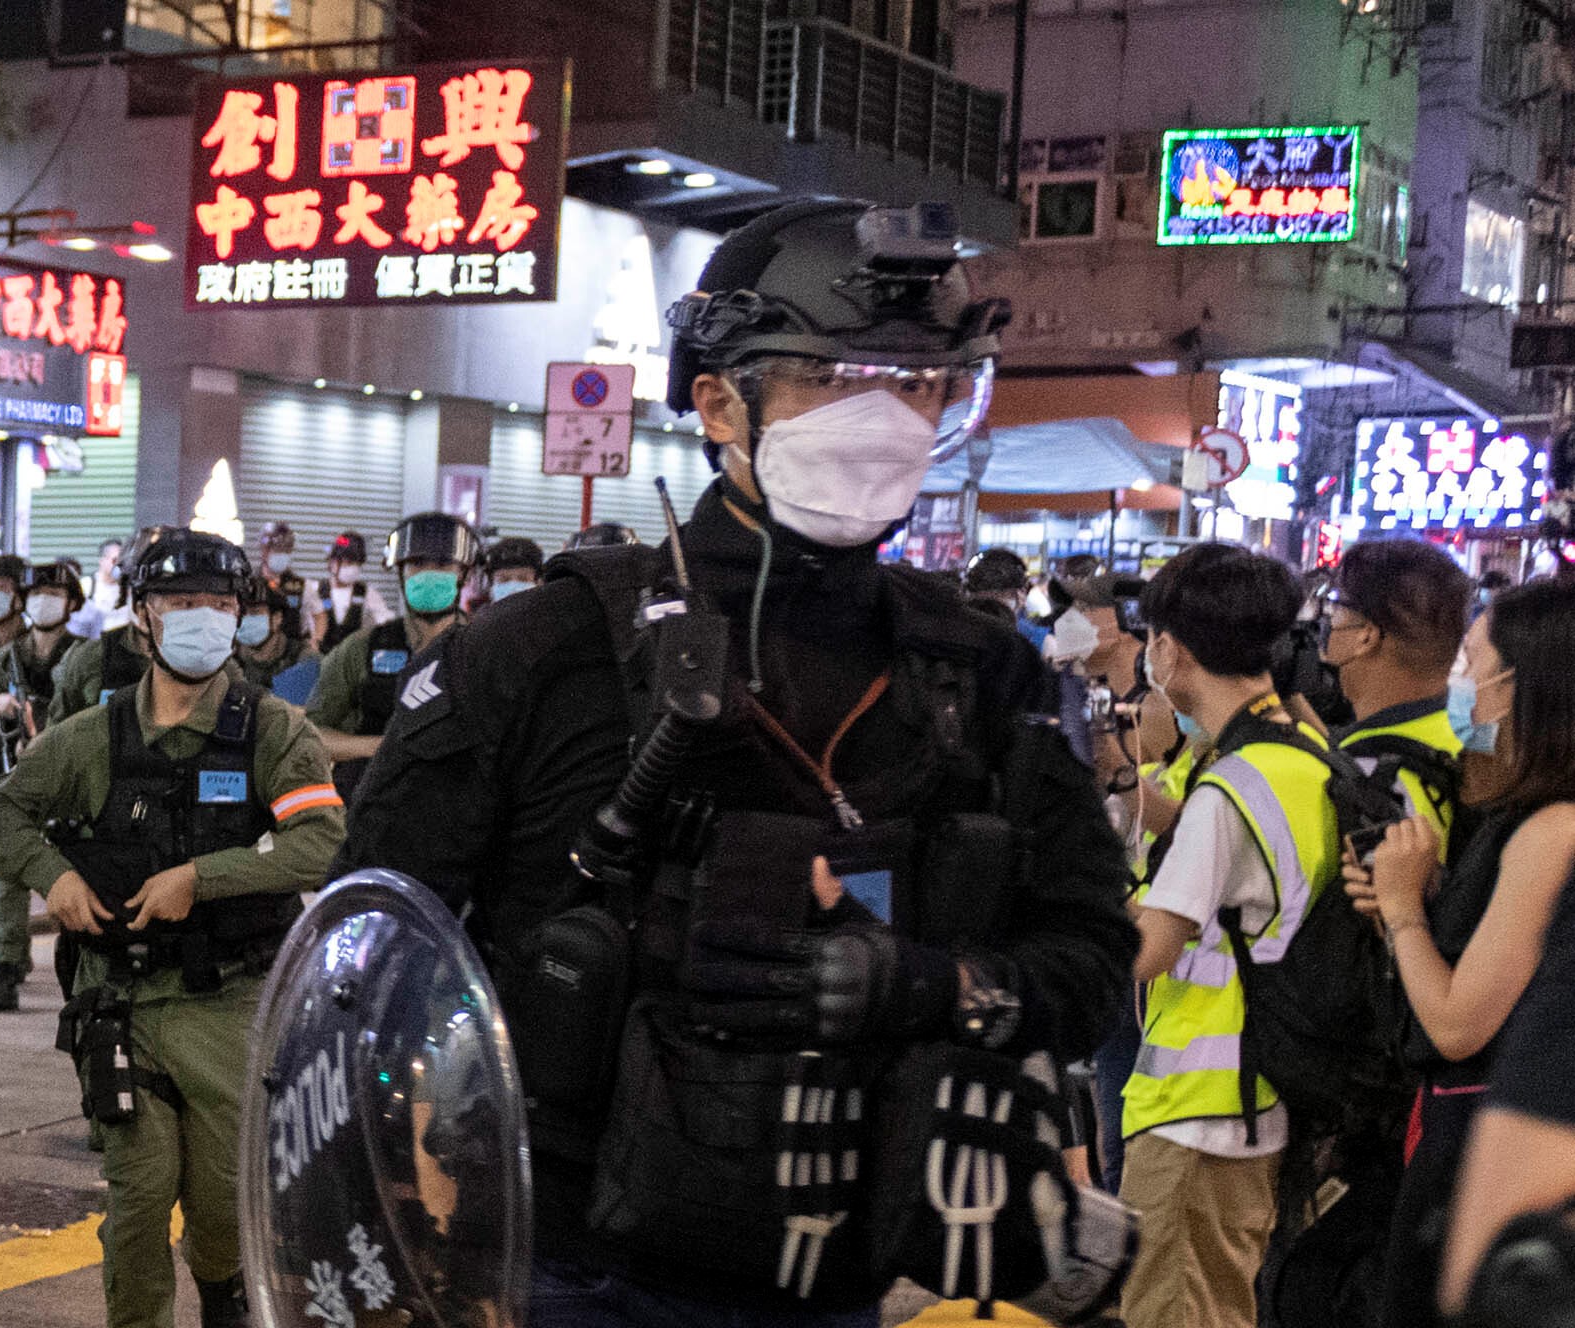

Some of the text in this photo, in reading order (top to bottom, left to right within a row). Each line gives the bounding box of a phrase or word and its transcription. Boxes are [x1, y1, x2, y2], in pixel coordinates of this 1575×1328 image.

[202, 68, 533, 181] 創 興
[195, 169, 539, 259] 中西大藥房
[5, 399, 61, 425] PHARMACY
[600, 417, 614, 438] 7
[600, 452, 624, 472] 12
[273, 1031, 350, 1193] POLICE
